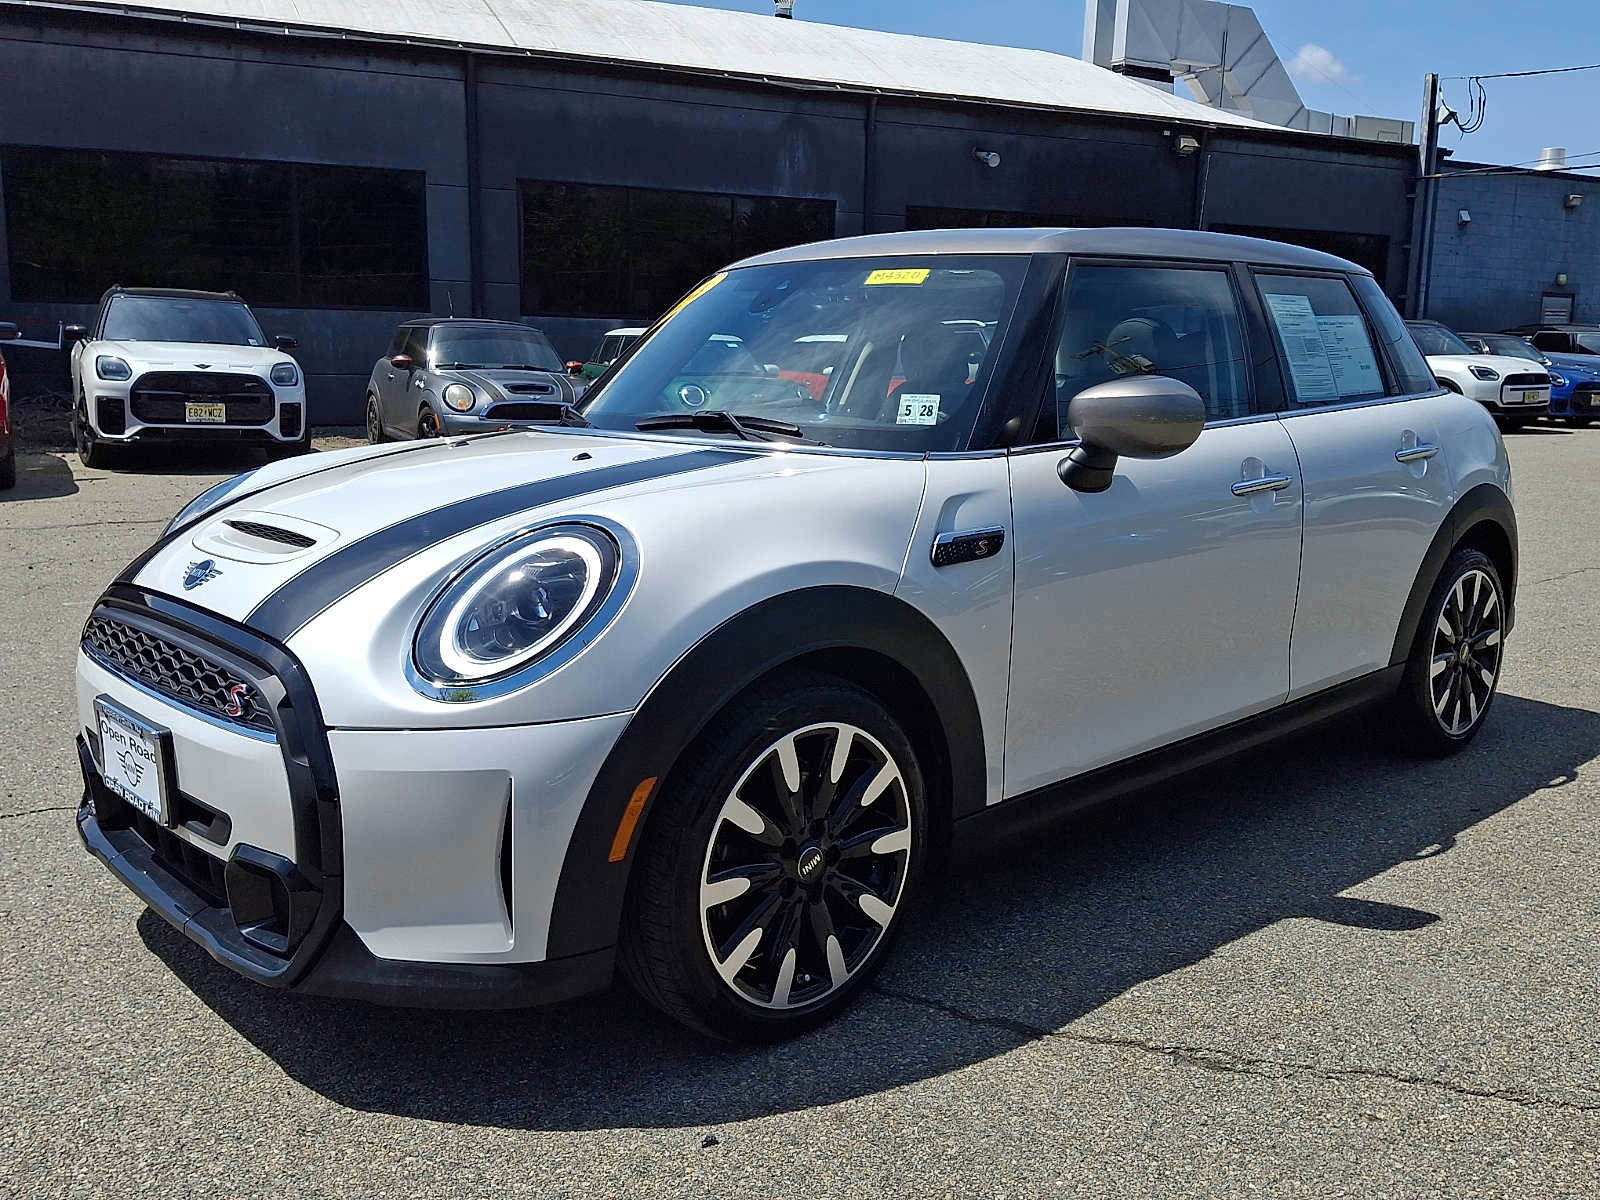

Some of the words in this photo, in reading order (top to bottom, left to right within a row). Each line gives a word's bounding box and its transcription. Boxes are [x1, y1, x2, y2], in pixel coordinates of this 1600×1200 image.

[904, 404, 912, 417] 5
[919, 404, 934, 417] 28
[975, 539, 989, 556] S
[225, 683, 247, 717] S
[101, 719, 126, 747] Open
[124, 789, 144, 813] ROAD
[802, 854, 820, 875] MINI
